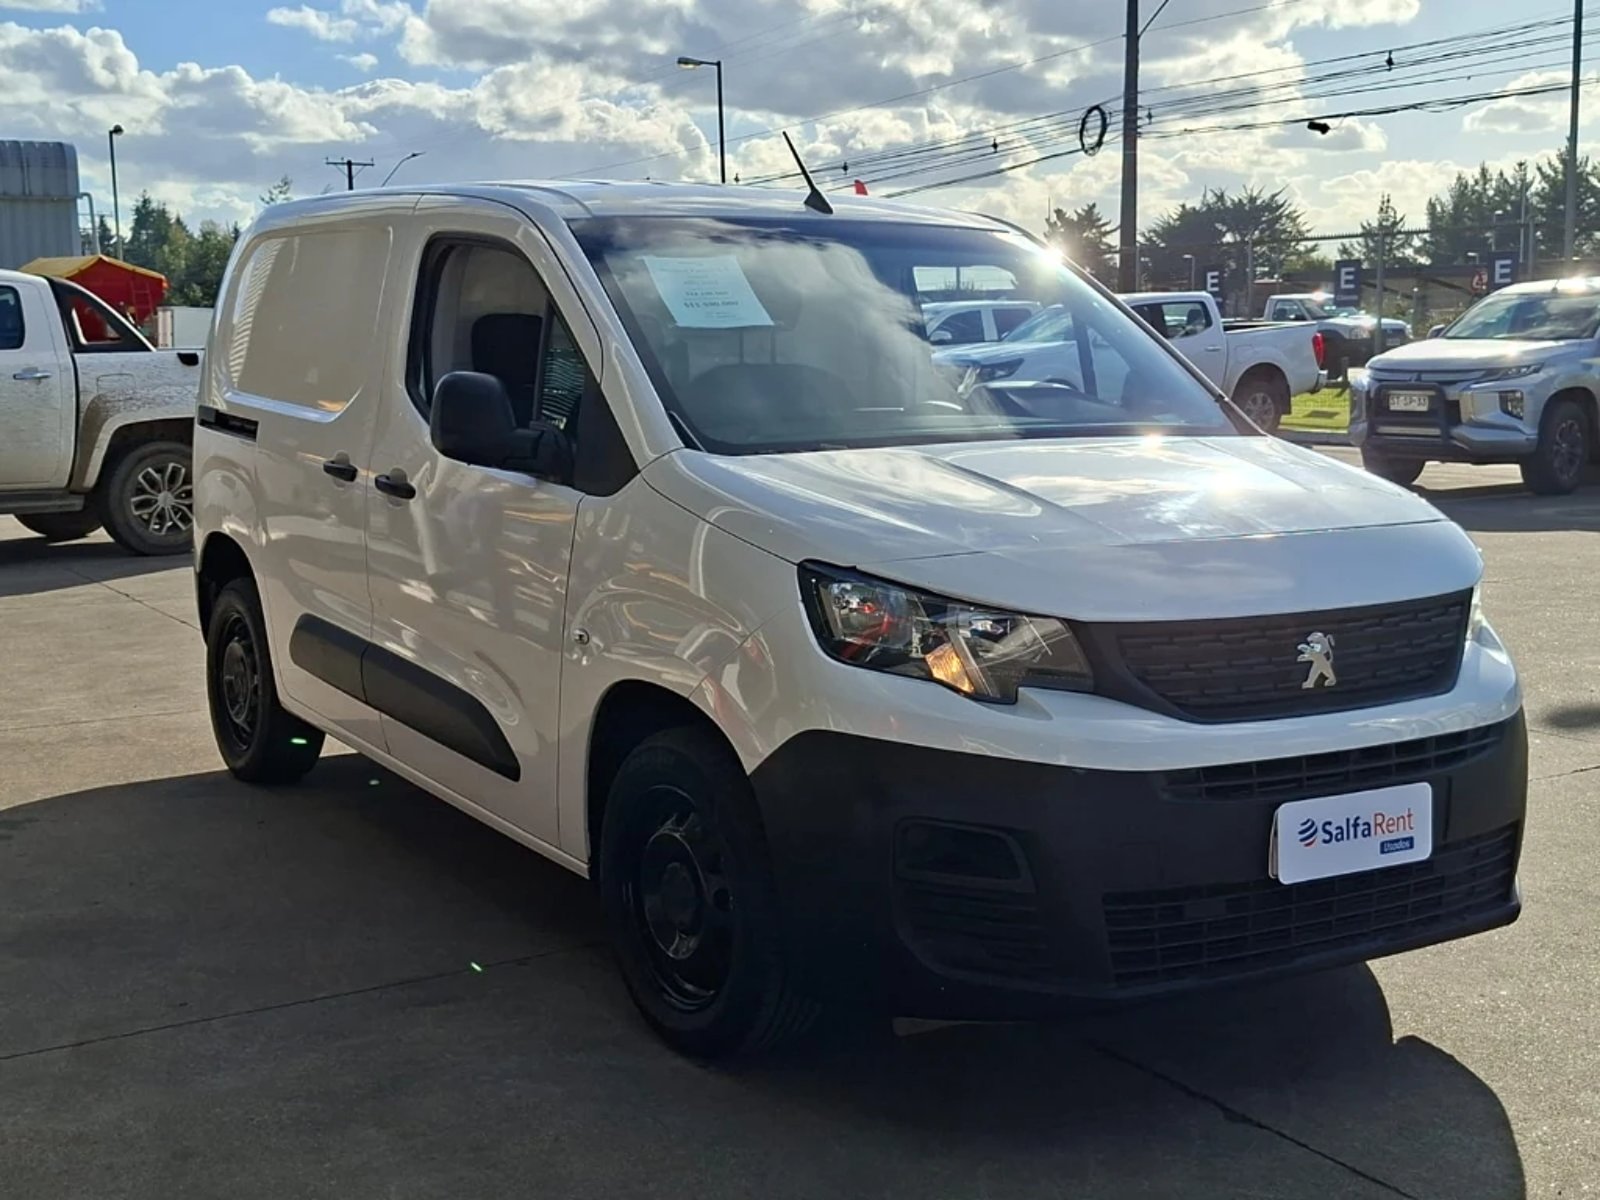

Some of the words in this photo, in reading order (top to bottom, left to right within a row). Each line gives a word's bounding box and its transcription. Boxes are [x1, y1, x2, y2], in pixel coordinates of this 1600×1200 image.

[1206, 271, 1220, 292] E
[1339, 266, 1356, 290] E
[1494, 259, 1512, 284] E
[1321, 808, 1414, 844] SalfaRent
